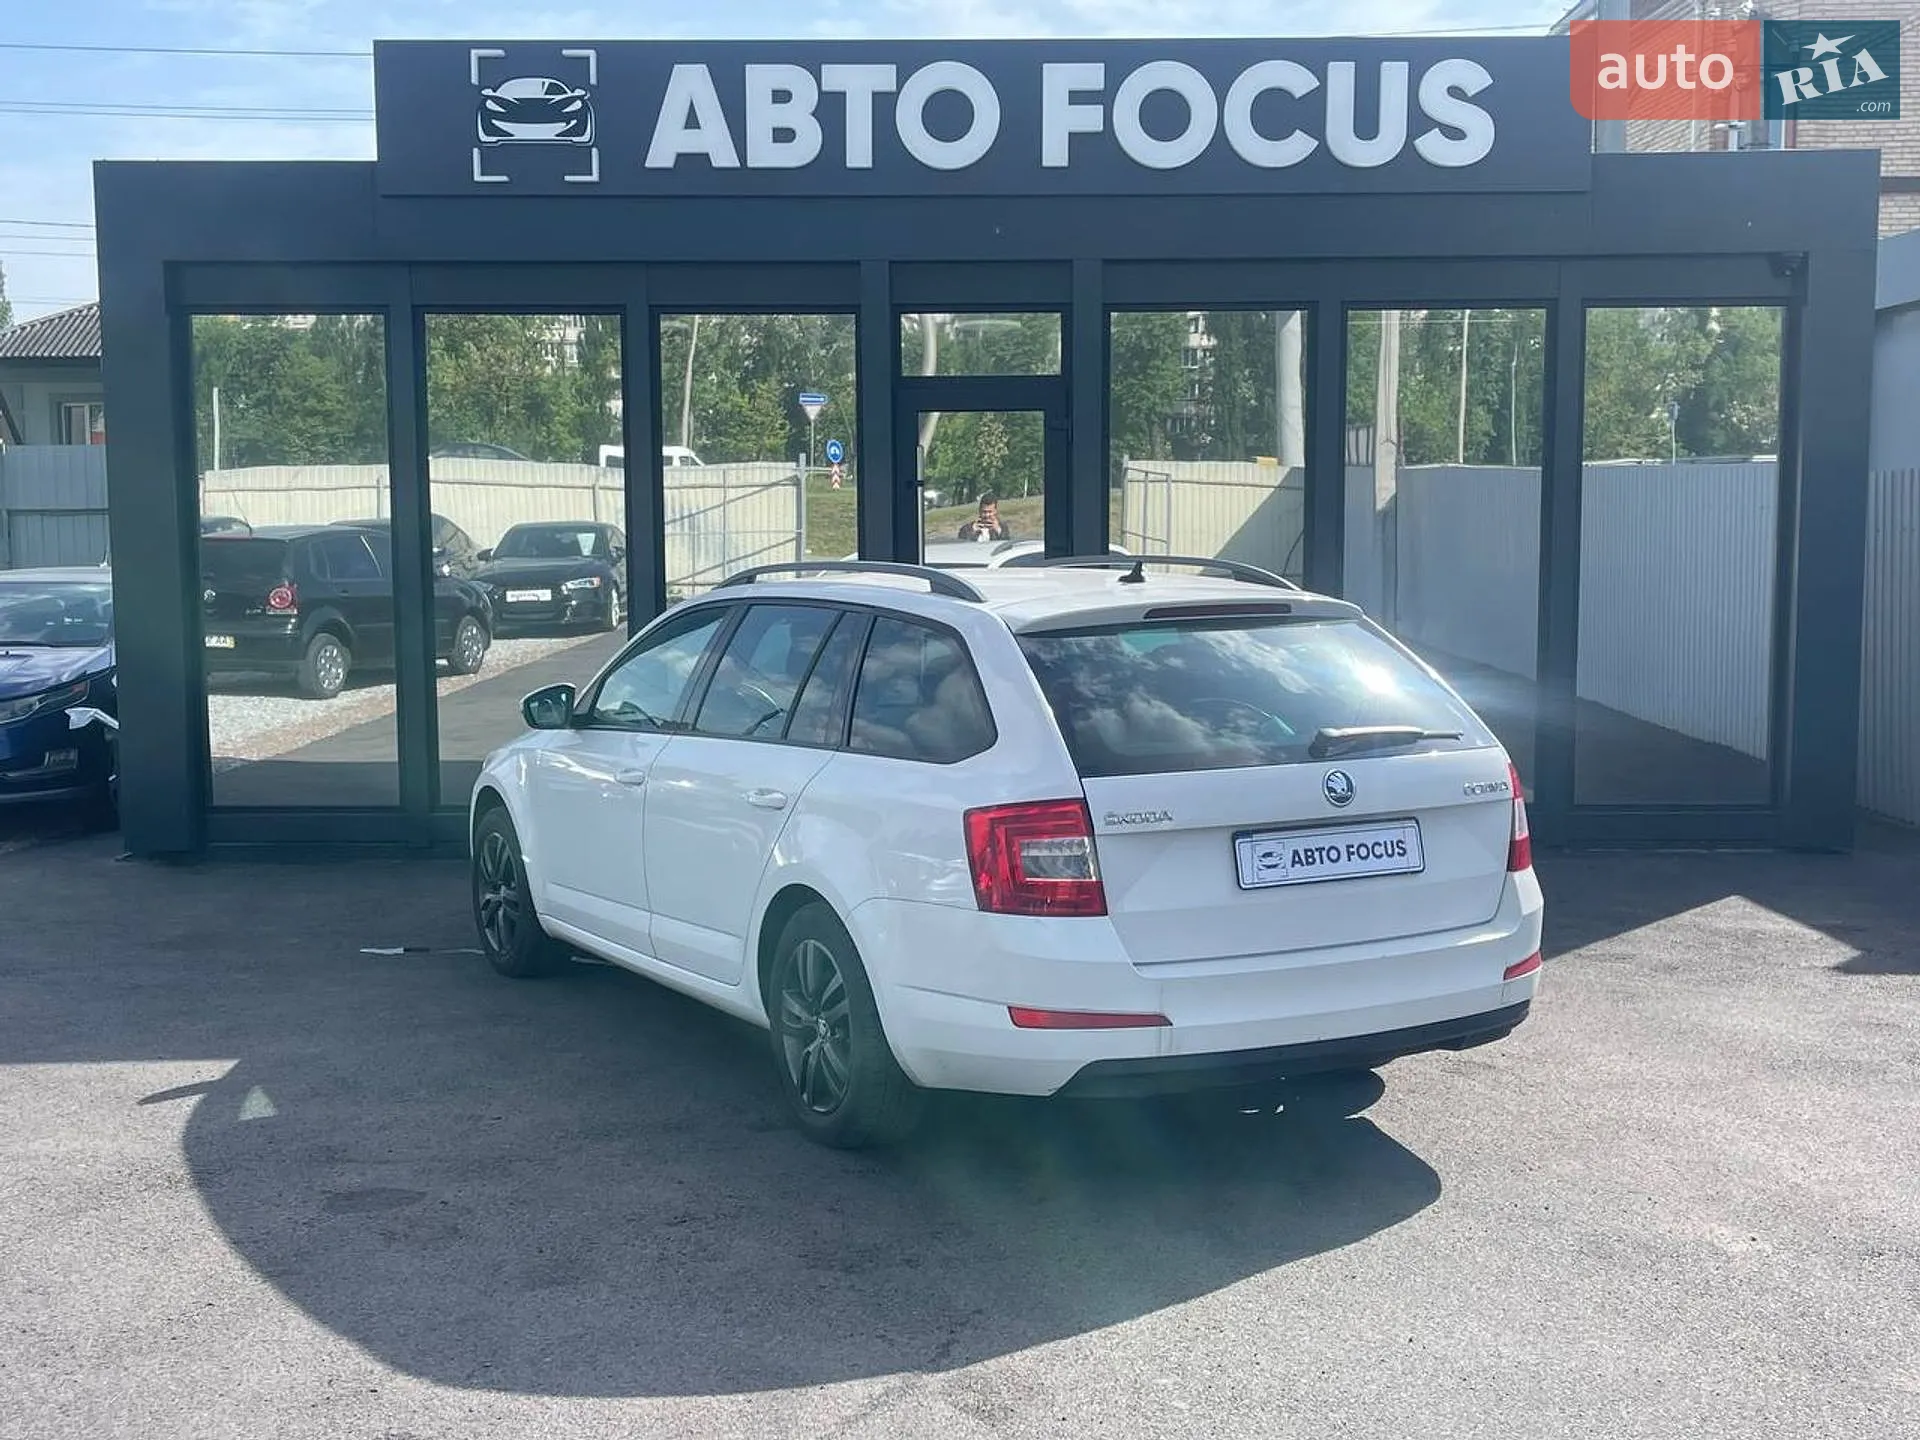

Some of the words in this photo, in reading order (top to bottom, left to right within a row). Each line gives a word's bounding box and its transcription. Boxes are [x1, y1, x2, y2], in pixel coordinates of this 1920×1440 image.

[644, 60, 1001, 170] АВТО
[1041, 58, 1497, 169] FOCUS
[1290, 845, 1341, 868] АВТО
[1345, 839, 1407, 862] FOCUS
